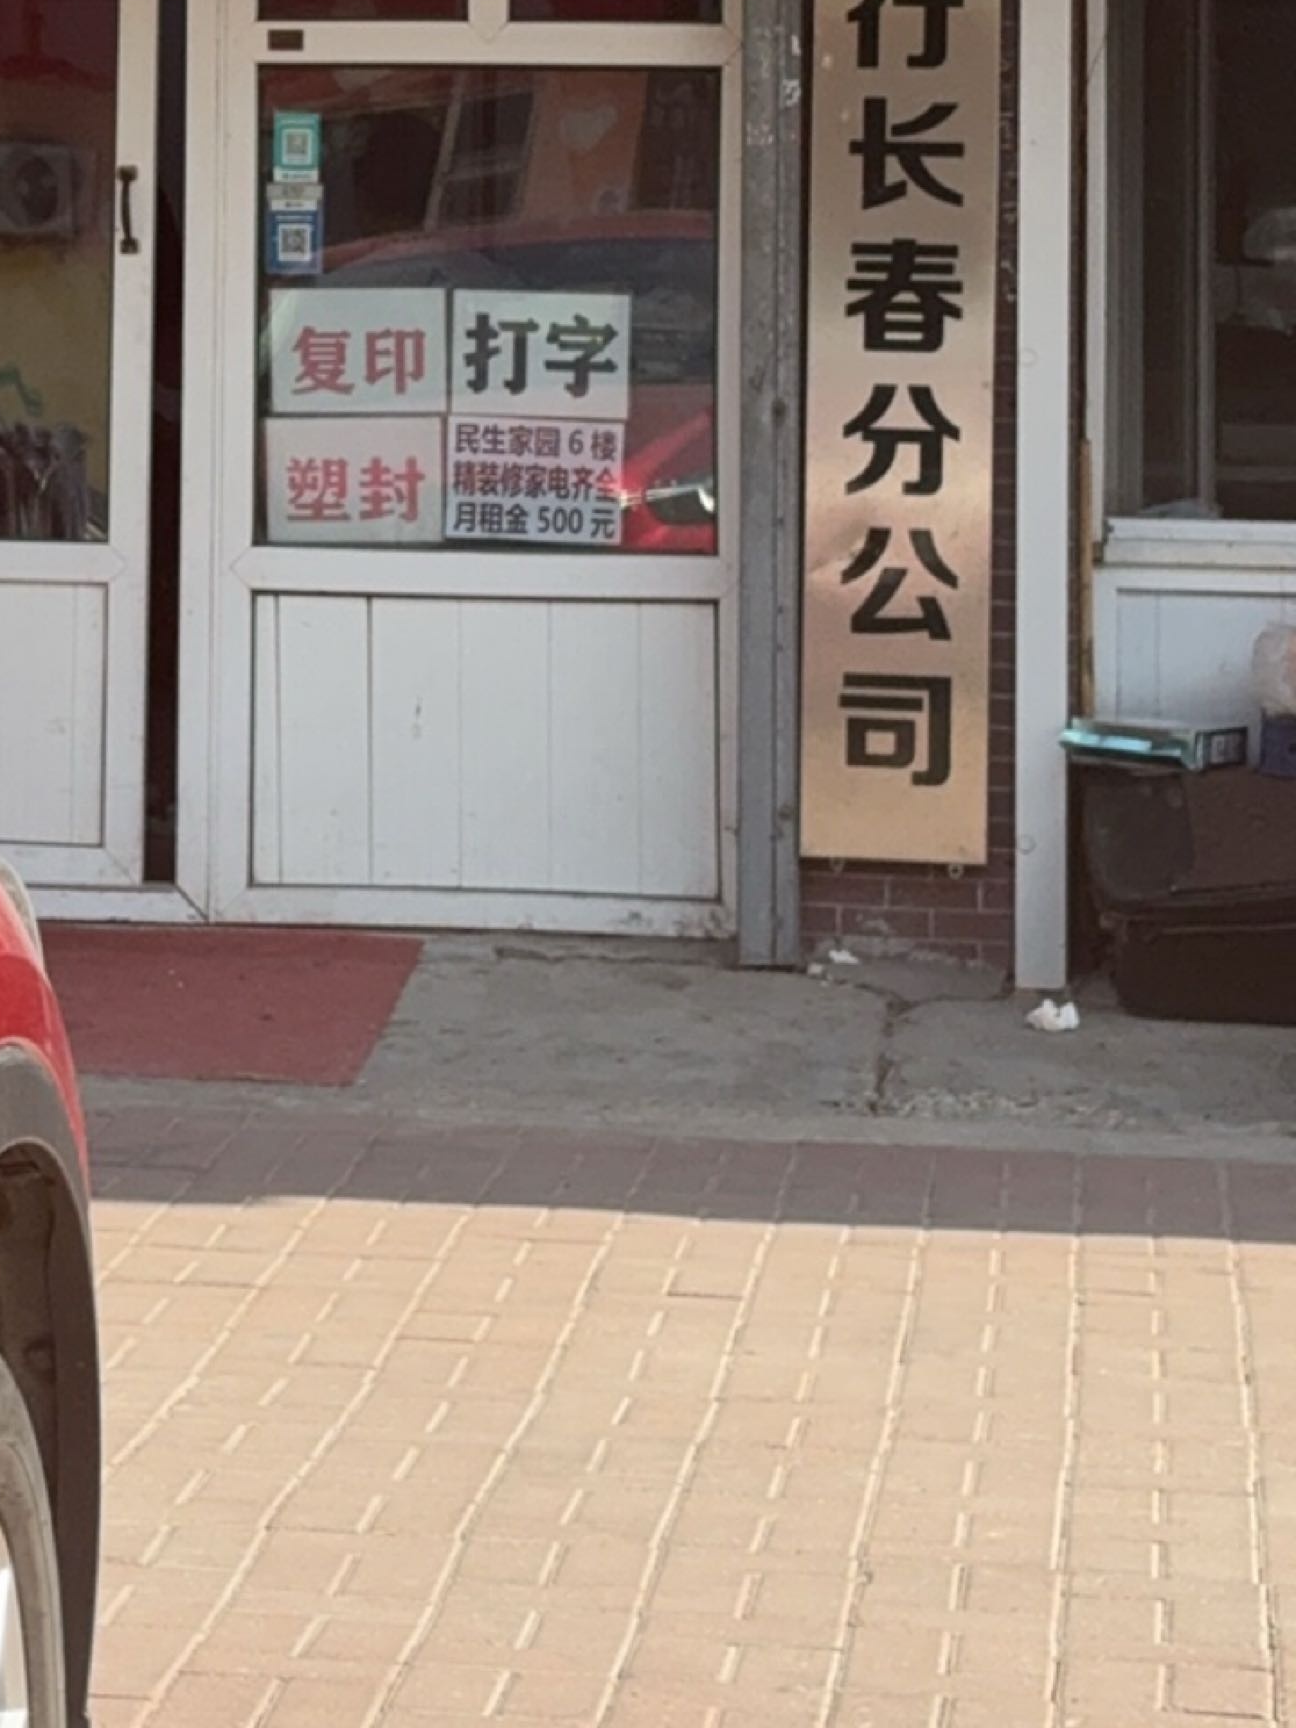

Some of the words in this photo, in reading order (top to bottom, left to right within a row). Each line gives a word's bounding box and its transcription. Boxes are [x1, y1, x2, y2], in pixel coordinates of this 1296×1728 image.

[291, 325, 427, 395] 复印
[463, 312, 619, 398] 打字
[287, 455, 425, 523] 塑封
[453, 461, 620, 504] 精装修家电齐全
